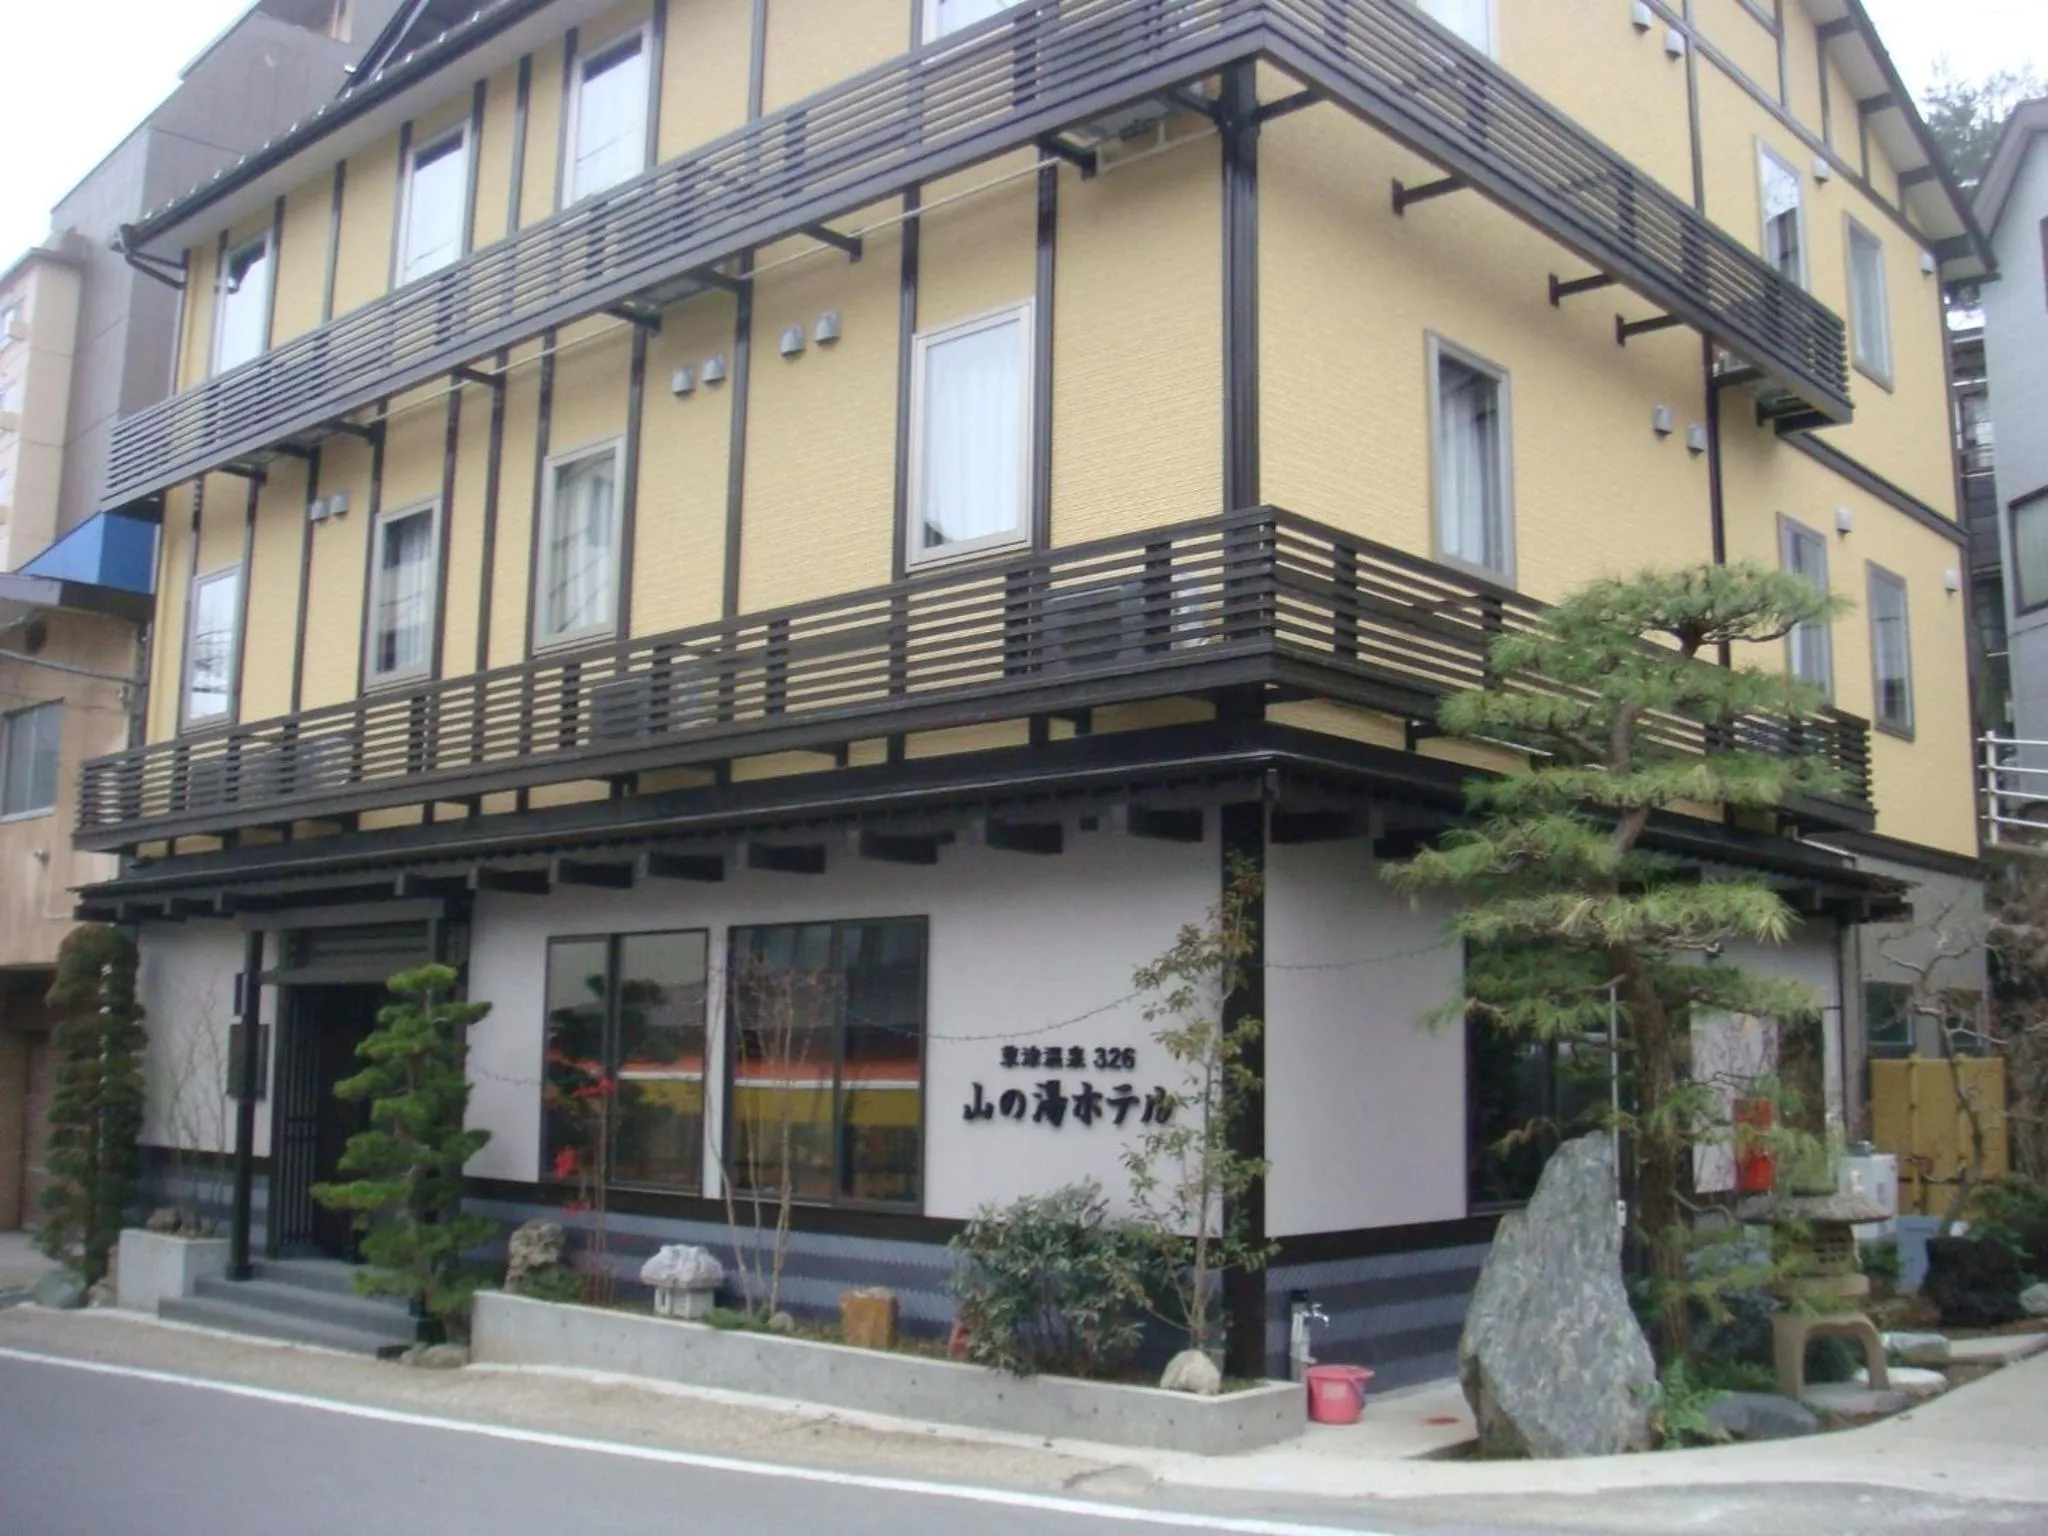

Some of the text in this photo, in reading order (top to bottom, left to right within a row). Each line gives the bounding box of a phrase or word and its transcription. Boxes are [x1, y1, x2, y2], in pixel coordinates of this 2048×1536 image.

[1093, 1047, 1136, 1069] 326
[963, 1080, 1174, 1127] 山の湯ホテル
